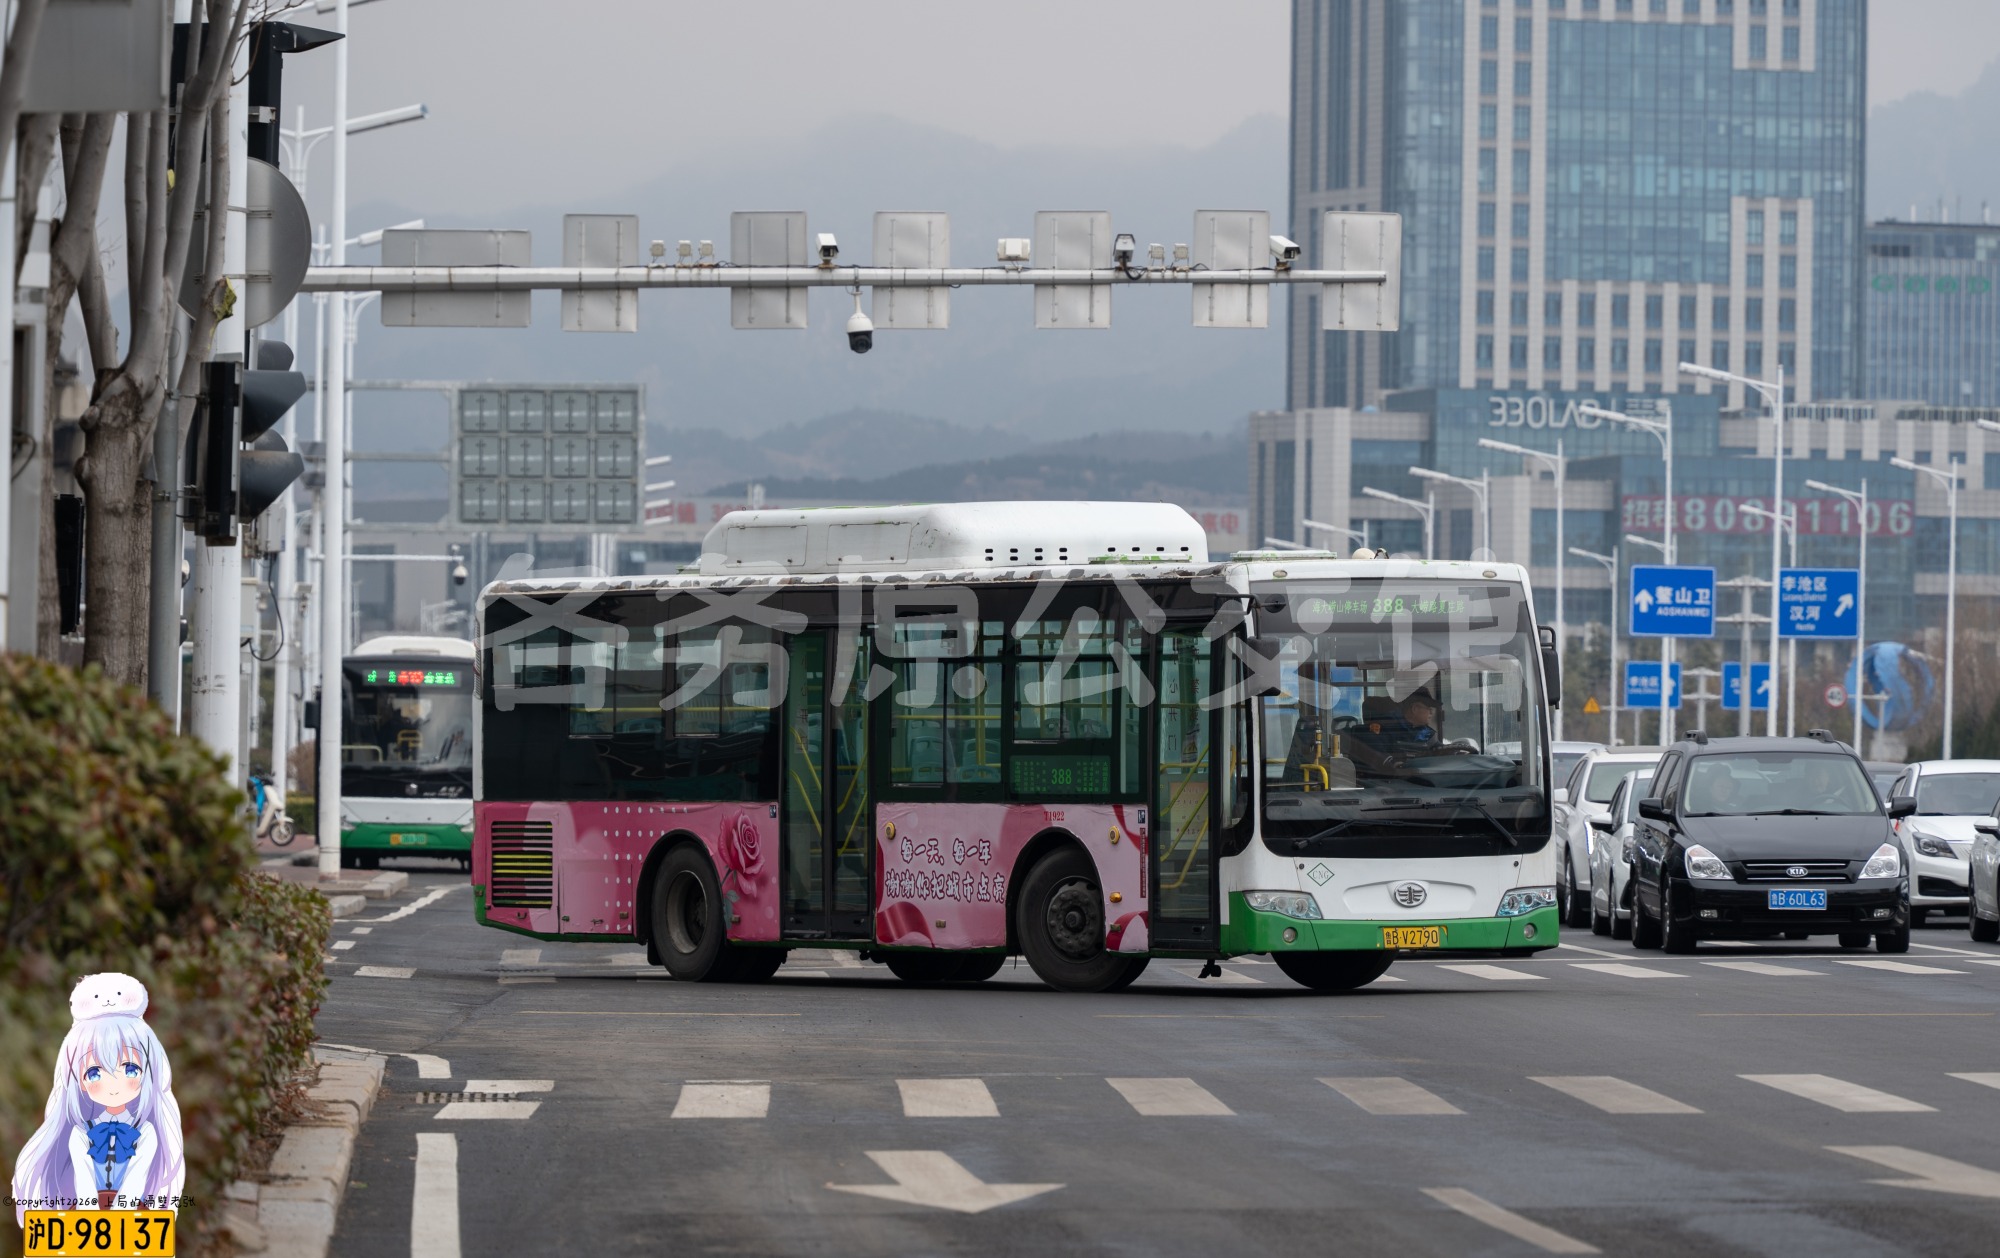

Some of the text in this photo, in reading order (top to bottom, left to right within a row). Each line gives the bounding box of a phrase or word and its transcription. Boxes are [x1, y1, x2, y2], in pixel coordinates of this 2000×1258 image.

[1782, 576, 1828, 592] 李沧区
[1372, 598, 1404, 613] 388
[1827, 690, 1843, 701] 40
[1051, 768, 1072, 785] 388
[1044, 811, 1064, 821] T1922
[1312, 870, 1329, 879] CNG
[885, 868, 1005, 904] 谢谢你把城市点亮
